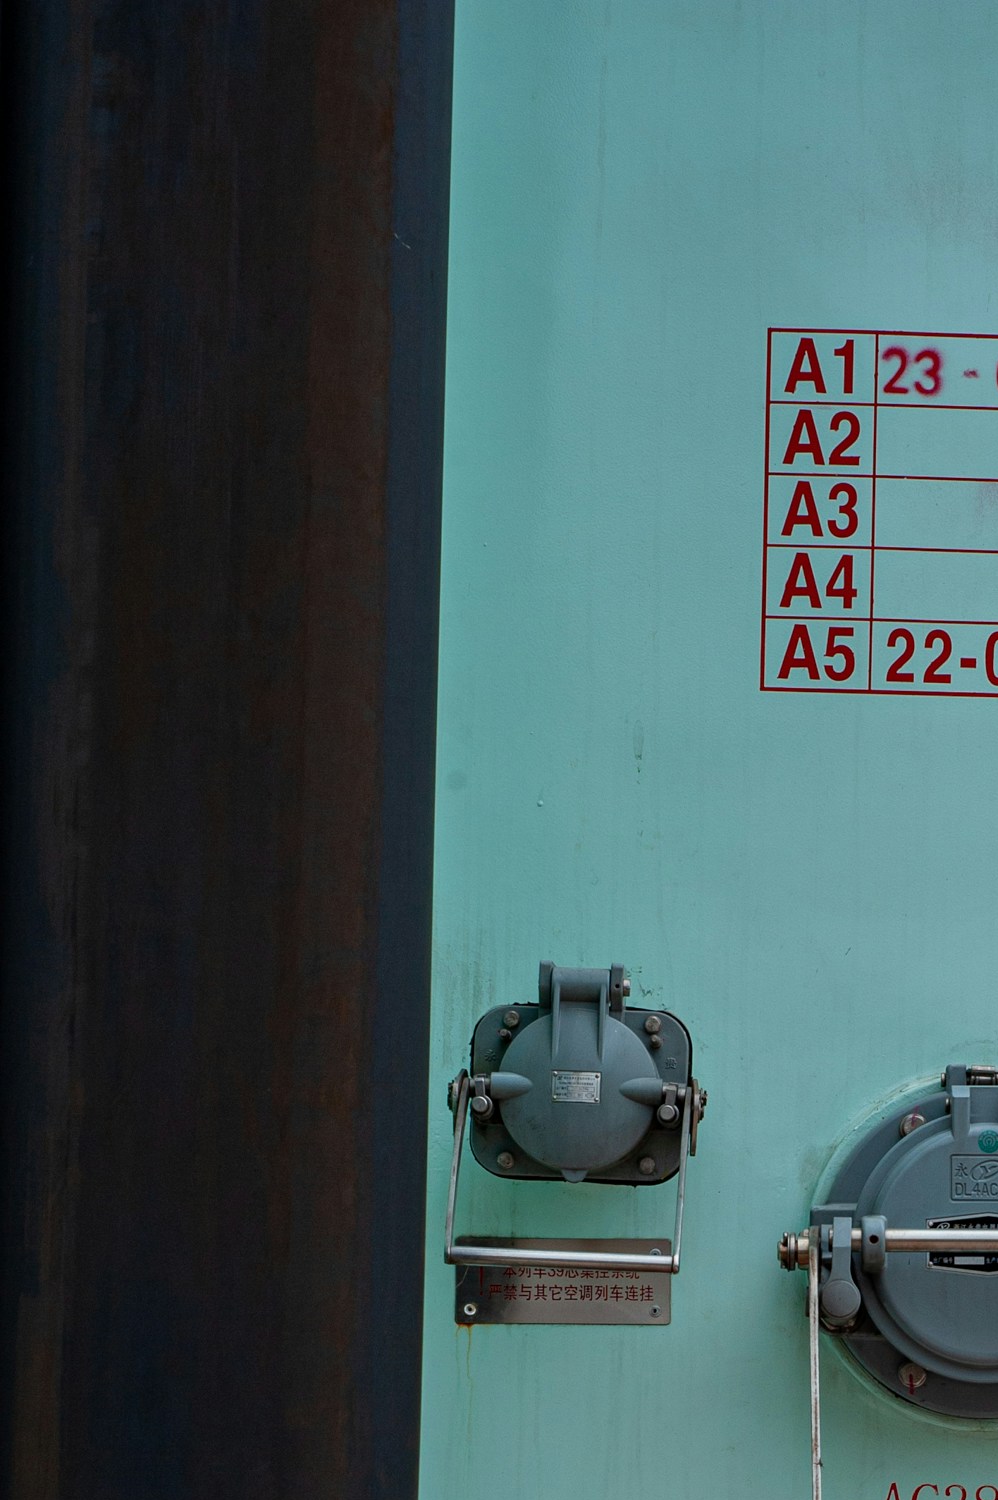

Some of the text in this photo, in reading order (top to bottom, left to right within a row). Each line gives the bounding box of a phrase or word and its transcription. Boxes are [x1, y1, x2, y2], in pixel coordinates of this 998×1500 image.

[784, 337, 856, 395] A1
[782, 409, 862, 467] A2
[781, 480, 859, 538] A3
[780, 552, 858, 610] A4
[777, 624, 856, 682] A5
[488, 1284, 654, 1303] 严禁与其它空调列车连挂
